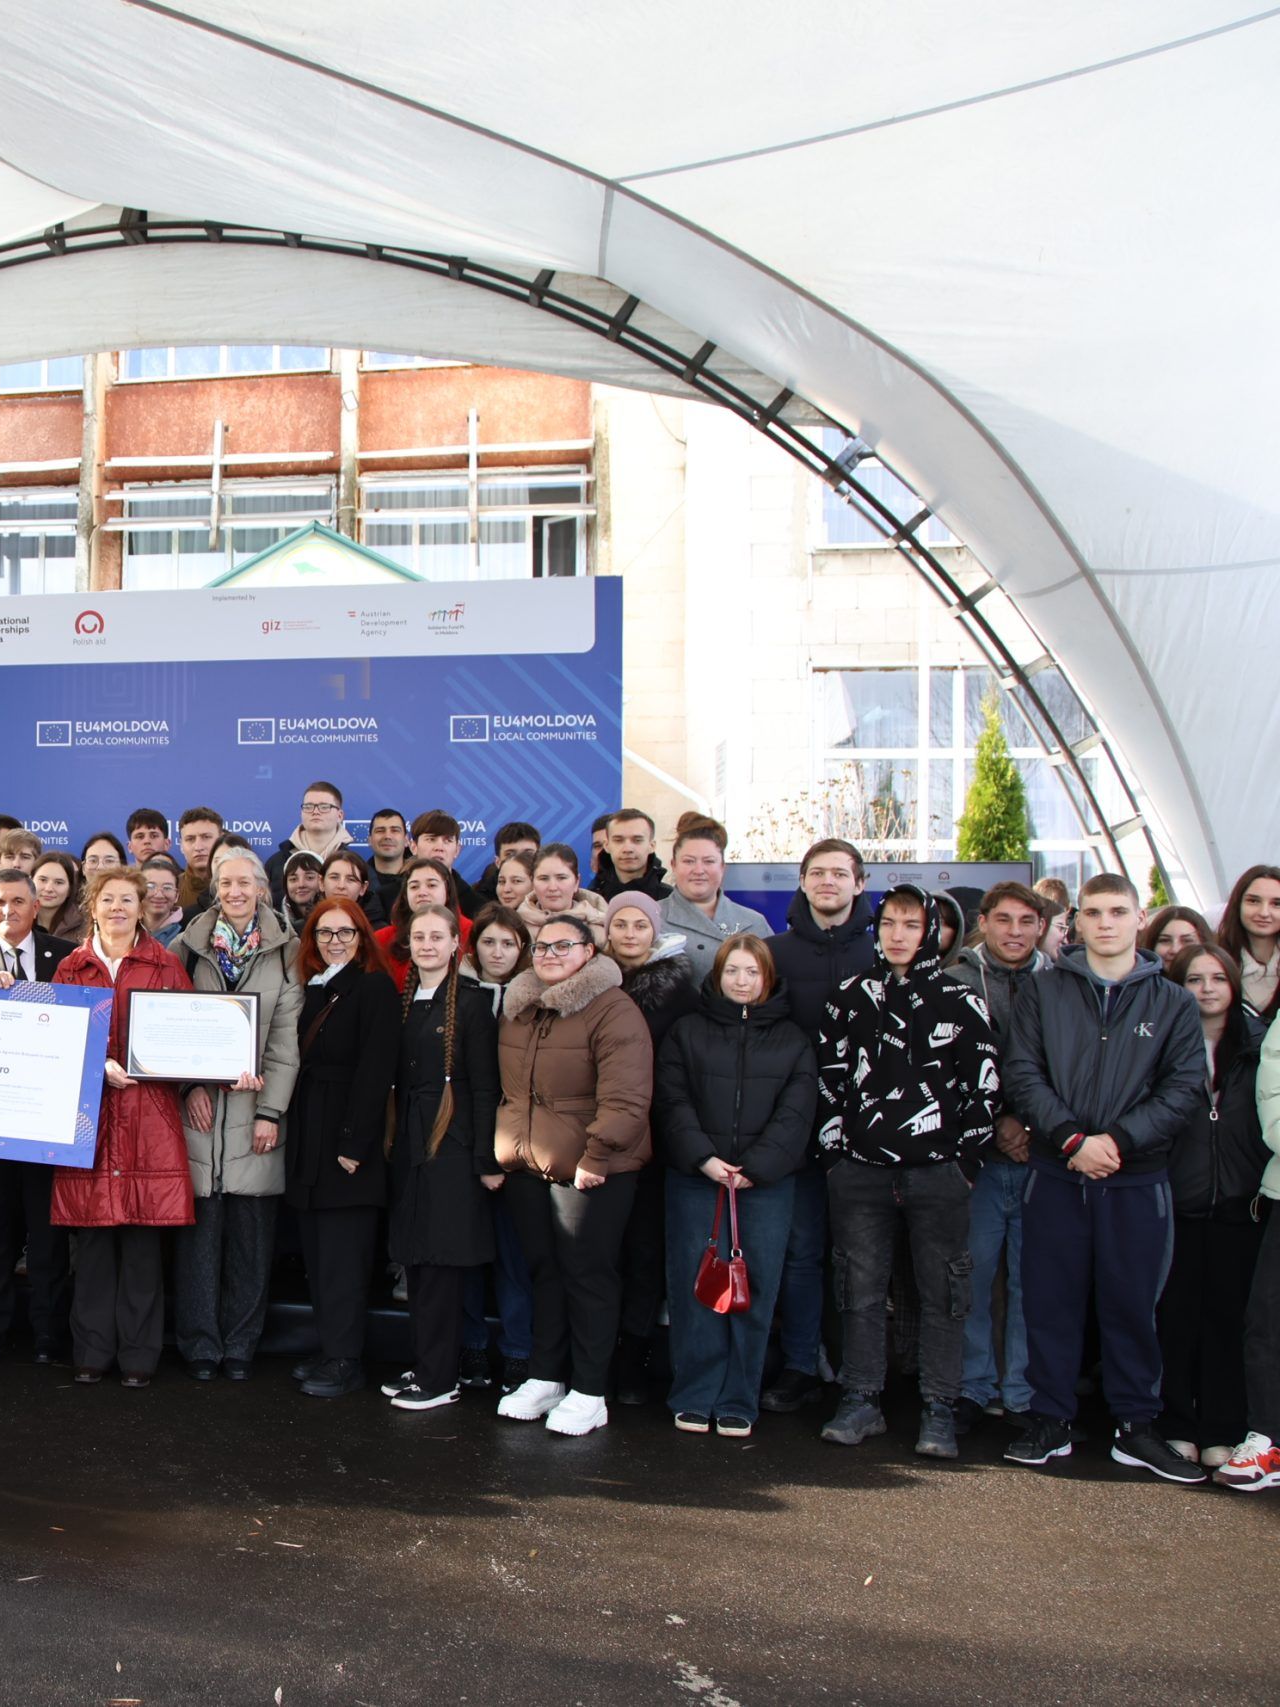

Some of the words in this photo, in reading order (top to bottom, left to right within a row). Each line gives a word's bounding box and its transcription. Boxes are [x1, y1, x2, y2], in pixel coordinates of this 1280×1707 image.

[360, 610, 391, 618] Austrian
[261, 619, 281, 635] giz
[360, 619, 408, 628] Development
[360, 629, 387, 637] Agency
[72, 637, 94, 646] Polish
[95, 637, 107, 646] aid
[75, 720, 169, 735] EU4MOLDOVA
[279, 717, 379, 732] EU4MOLDOVA
[493, 714, 597, 729] EU4MOLDOVA
[75, 736, 104, 747] LOCAL
[105, 736, 169, 747] COMMUNITIES
[279, 733, 310, 745] LOCAL
[310, 733, 379, 745] COMMUNITIES
[493, 731, 525, 742] LOCAL
[526, 731, 597, 742] COMMUNITIES
[933, 1022, 955, 1037] NIK
[910, 1111, 942, 1137] NIKE
